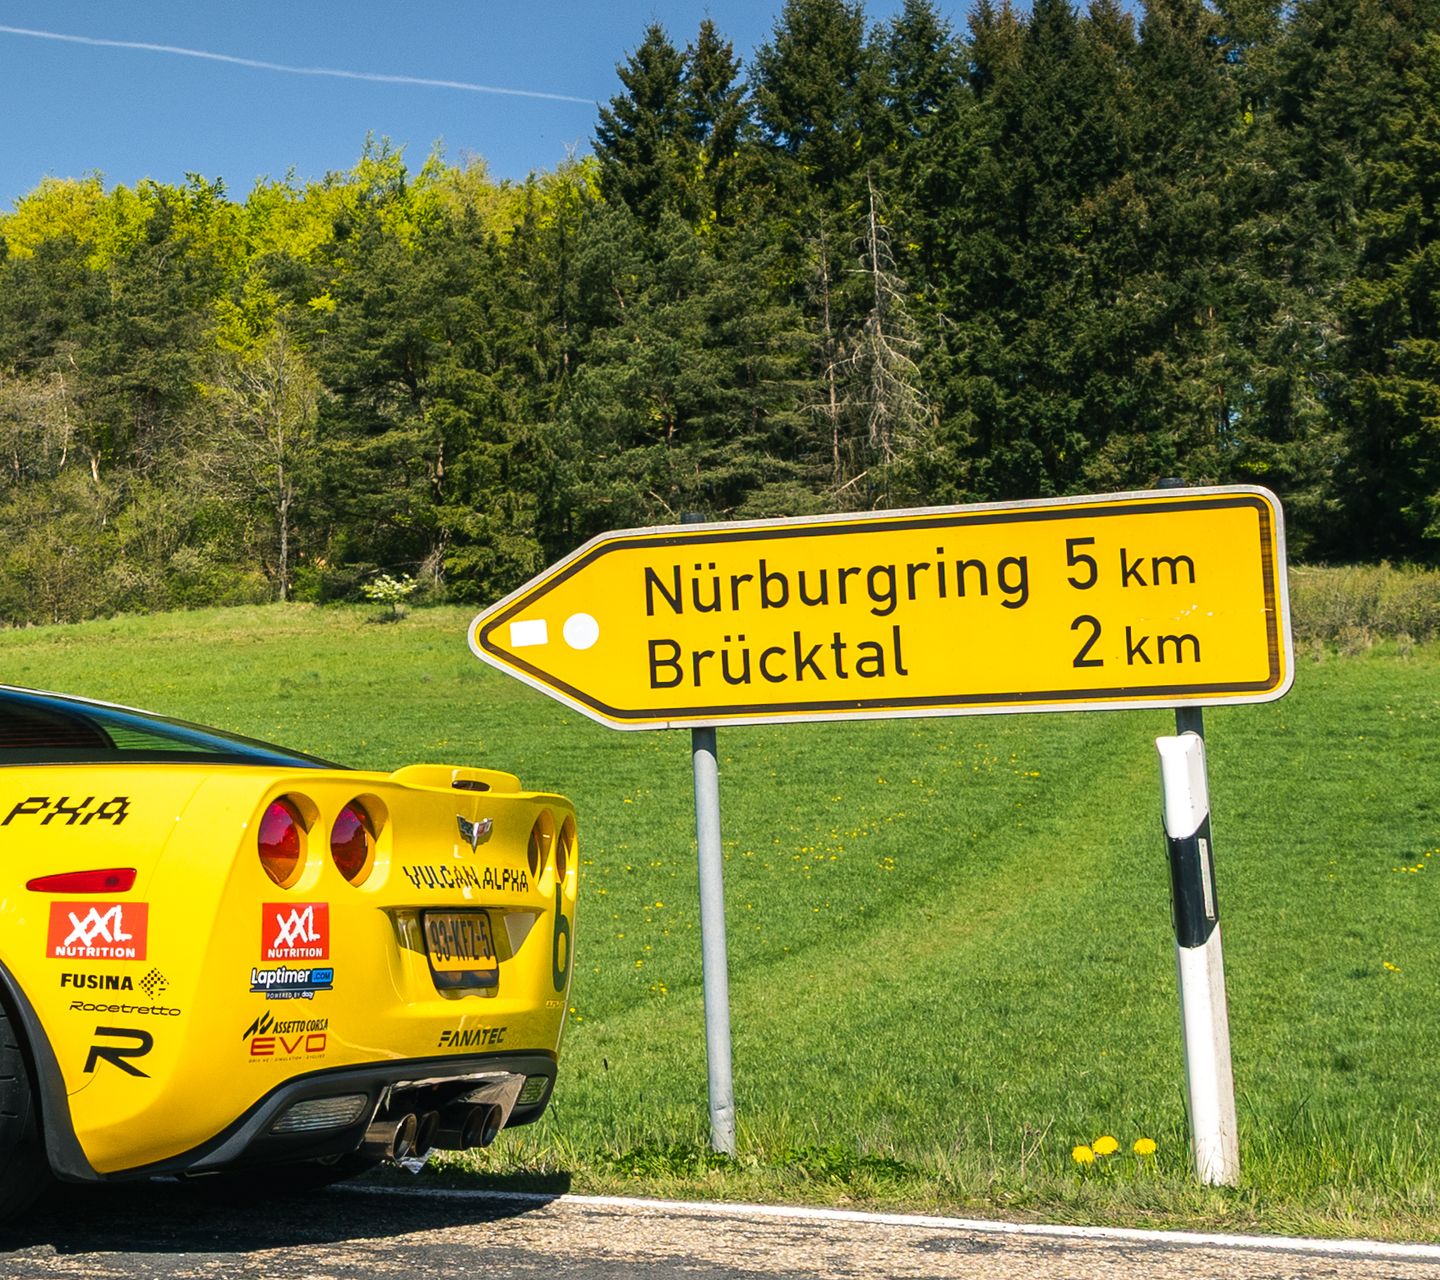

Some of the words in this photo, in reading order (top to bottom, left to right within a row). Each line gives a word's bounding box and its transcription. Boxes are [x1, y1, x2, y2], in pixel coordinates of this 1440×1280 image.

[643, 546, 1030, 617] Nürburgring
[1064, 536, 1099, 591] 5
[1119, 547, 1197, 588] km
[647, 624, 909, 690] Brücktal
[1069, 614, 1105, 669] 2
[1125, 625, 1202, 666] km
[402, 865, 481, 890] VULCAN
[482, 867, 530, 893] ALPHA
[64, 904, 133, 947] XXL
[273, 905, 321, 949] XXL
[55, 945, 136, 959] NUTRITION
[267, 948, 323, 959] NUTRITION
[60, 973, 134, 991] FUSINA
[272, 1019, 306, 1035] ASSETTO
[305, 1018, 329, 1033] CORSA
[437, 1027, 508, 1048] FANATEC
[250, 1033, 327, 1056] EVO
